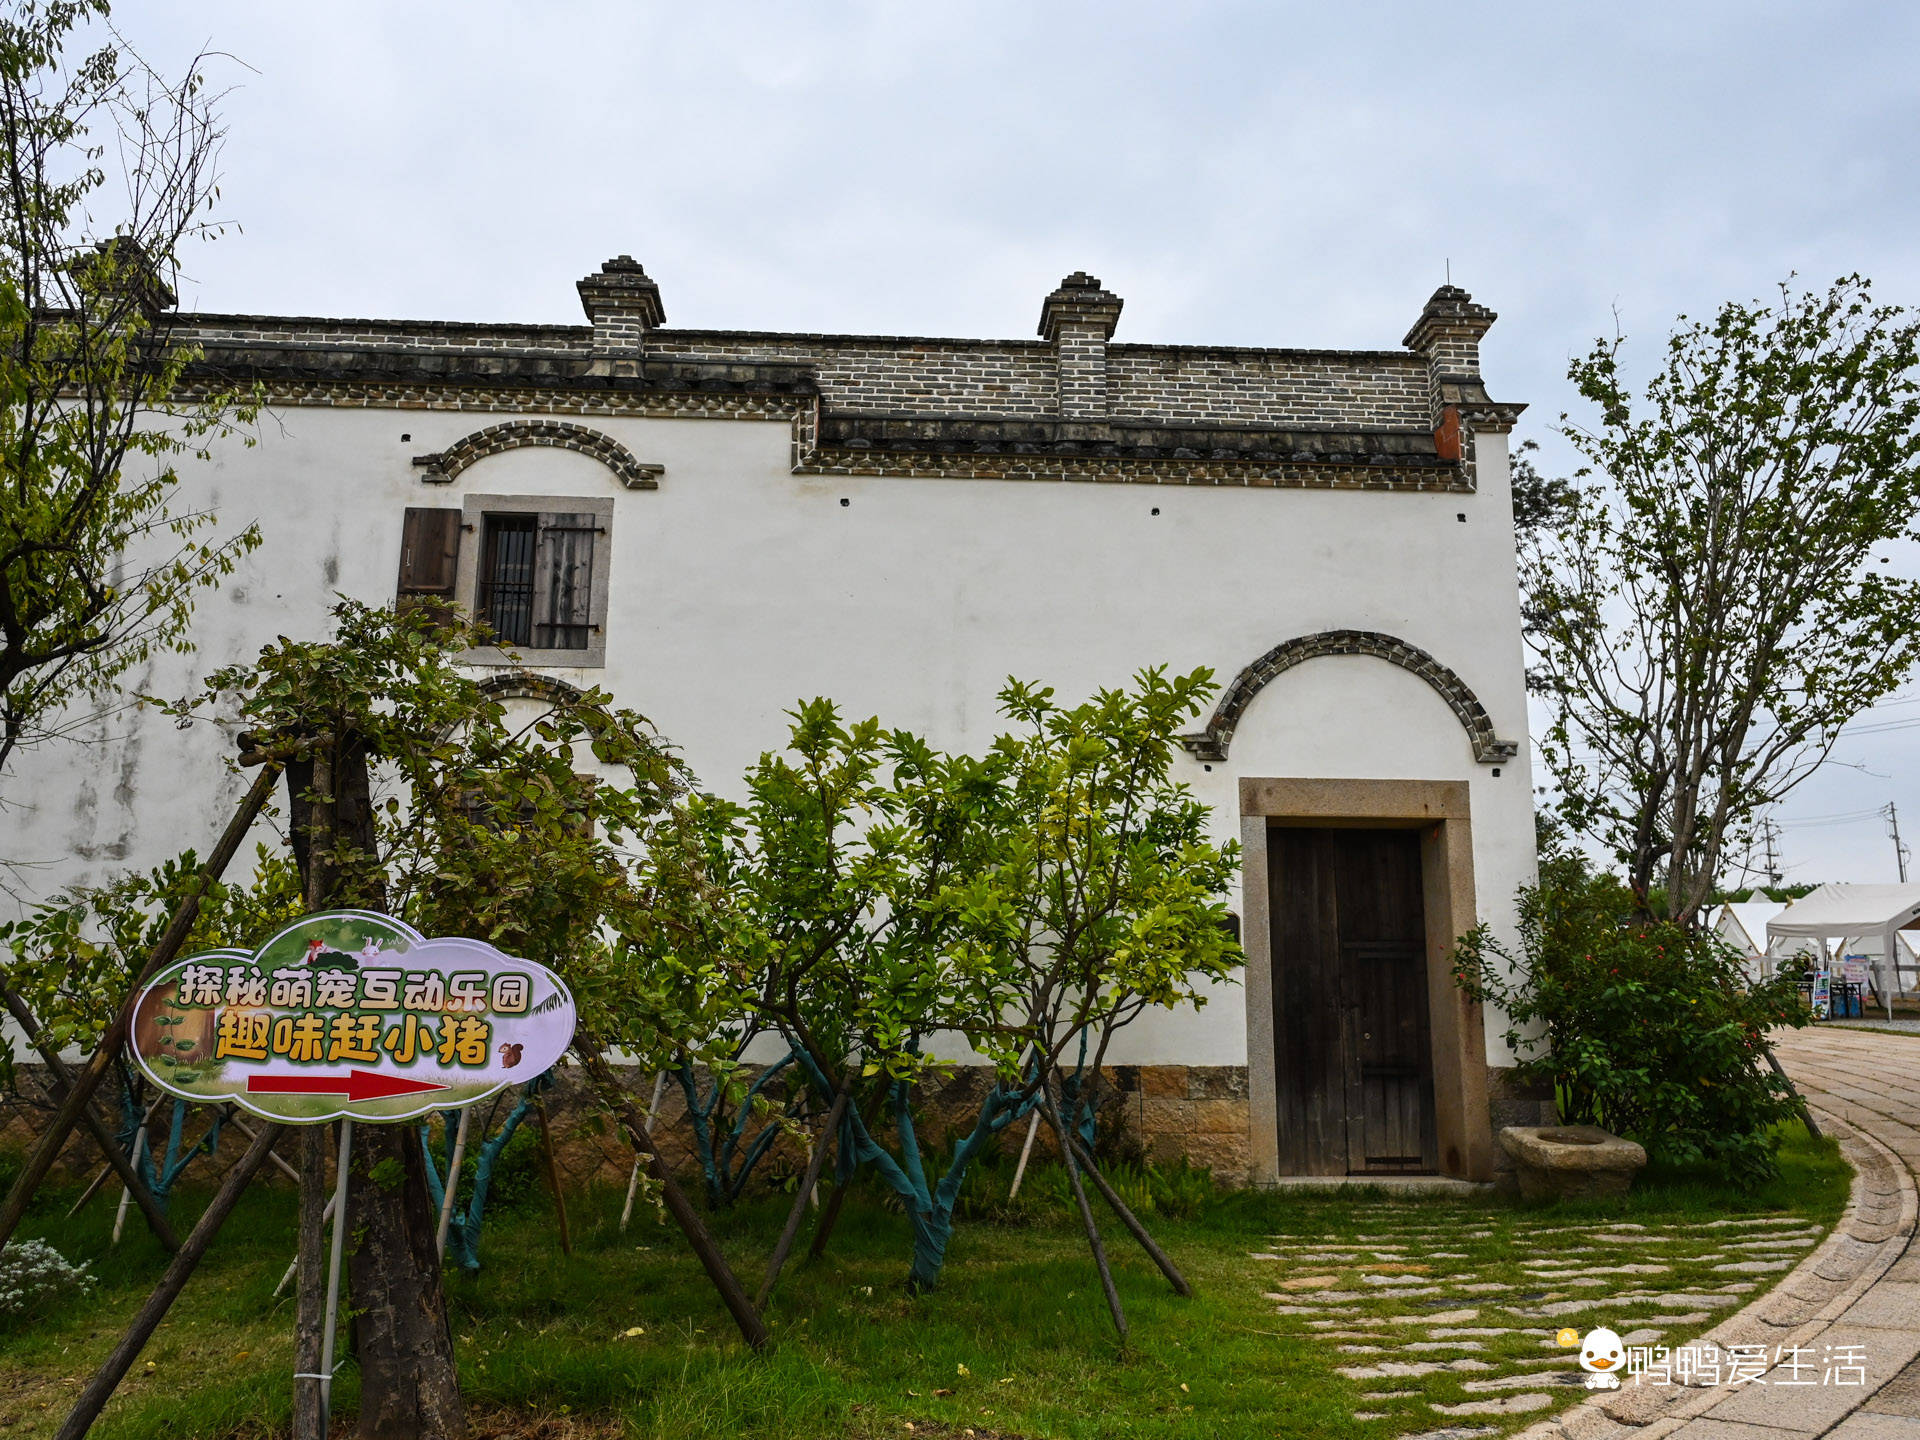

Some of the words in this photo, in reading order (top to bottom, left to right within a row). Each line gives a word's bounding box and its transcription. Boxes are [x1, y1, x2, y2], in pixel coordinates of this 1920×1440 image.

[179, 965, 529, 1013] 探秘萌宠互动乐园
[215, 1009, 489, 1065] 趣味赶小猪
